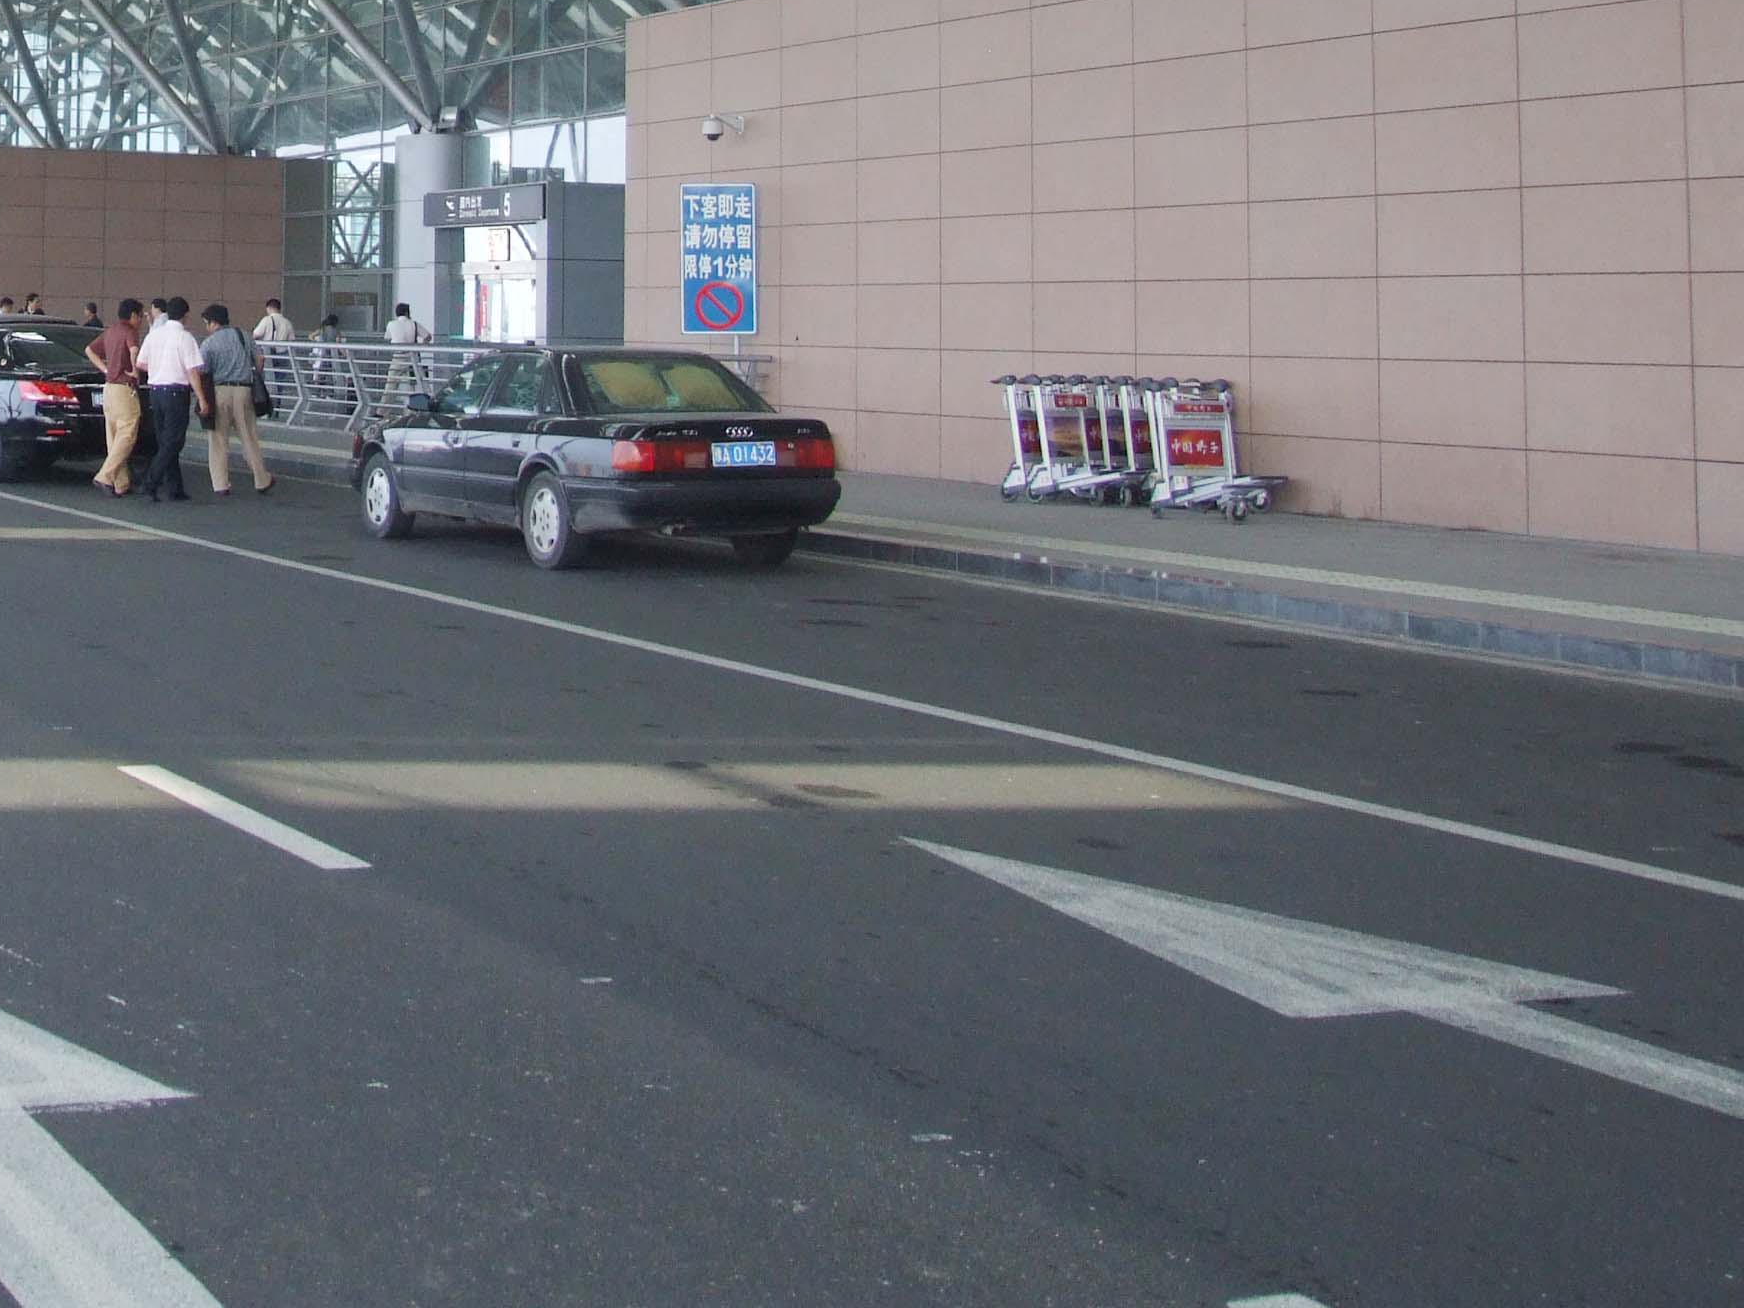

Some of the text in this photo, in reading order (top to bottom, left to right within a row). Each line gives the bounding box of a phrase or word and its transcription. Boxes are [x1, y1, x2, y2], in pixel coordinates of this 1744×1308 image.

[503, 193, 511, 217] 5
[683, 193, 752, 219] 下客即走
[684, 223, 752, 250] 请勿停留
[684, 254, 753, 280] 限停1分钟
